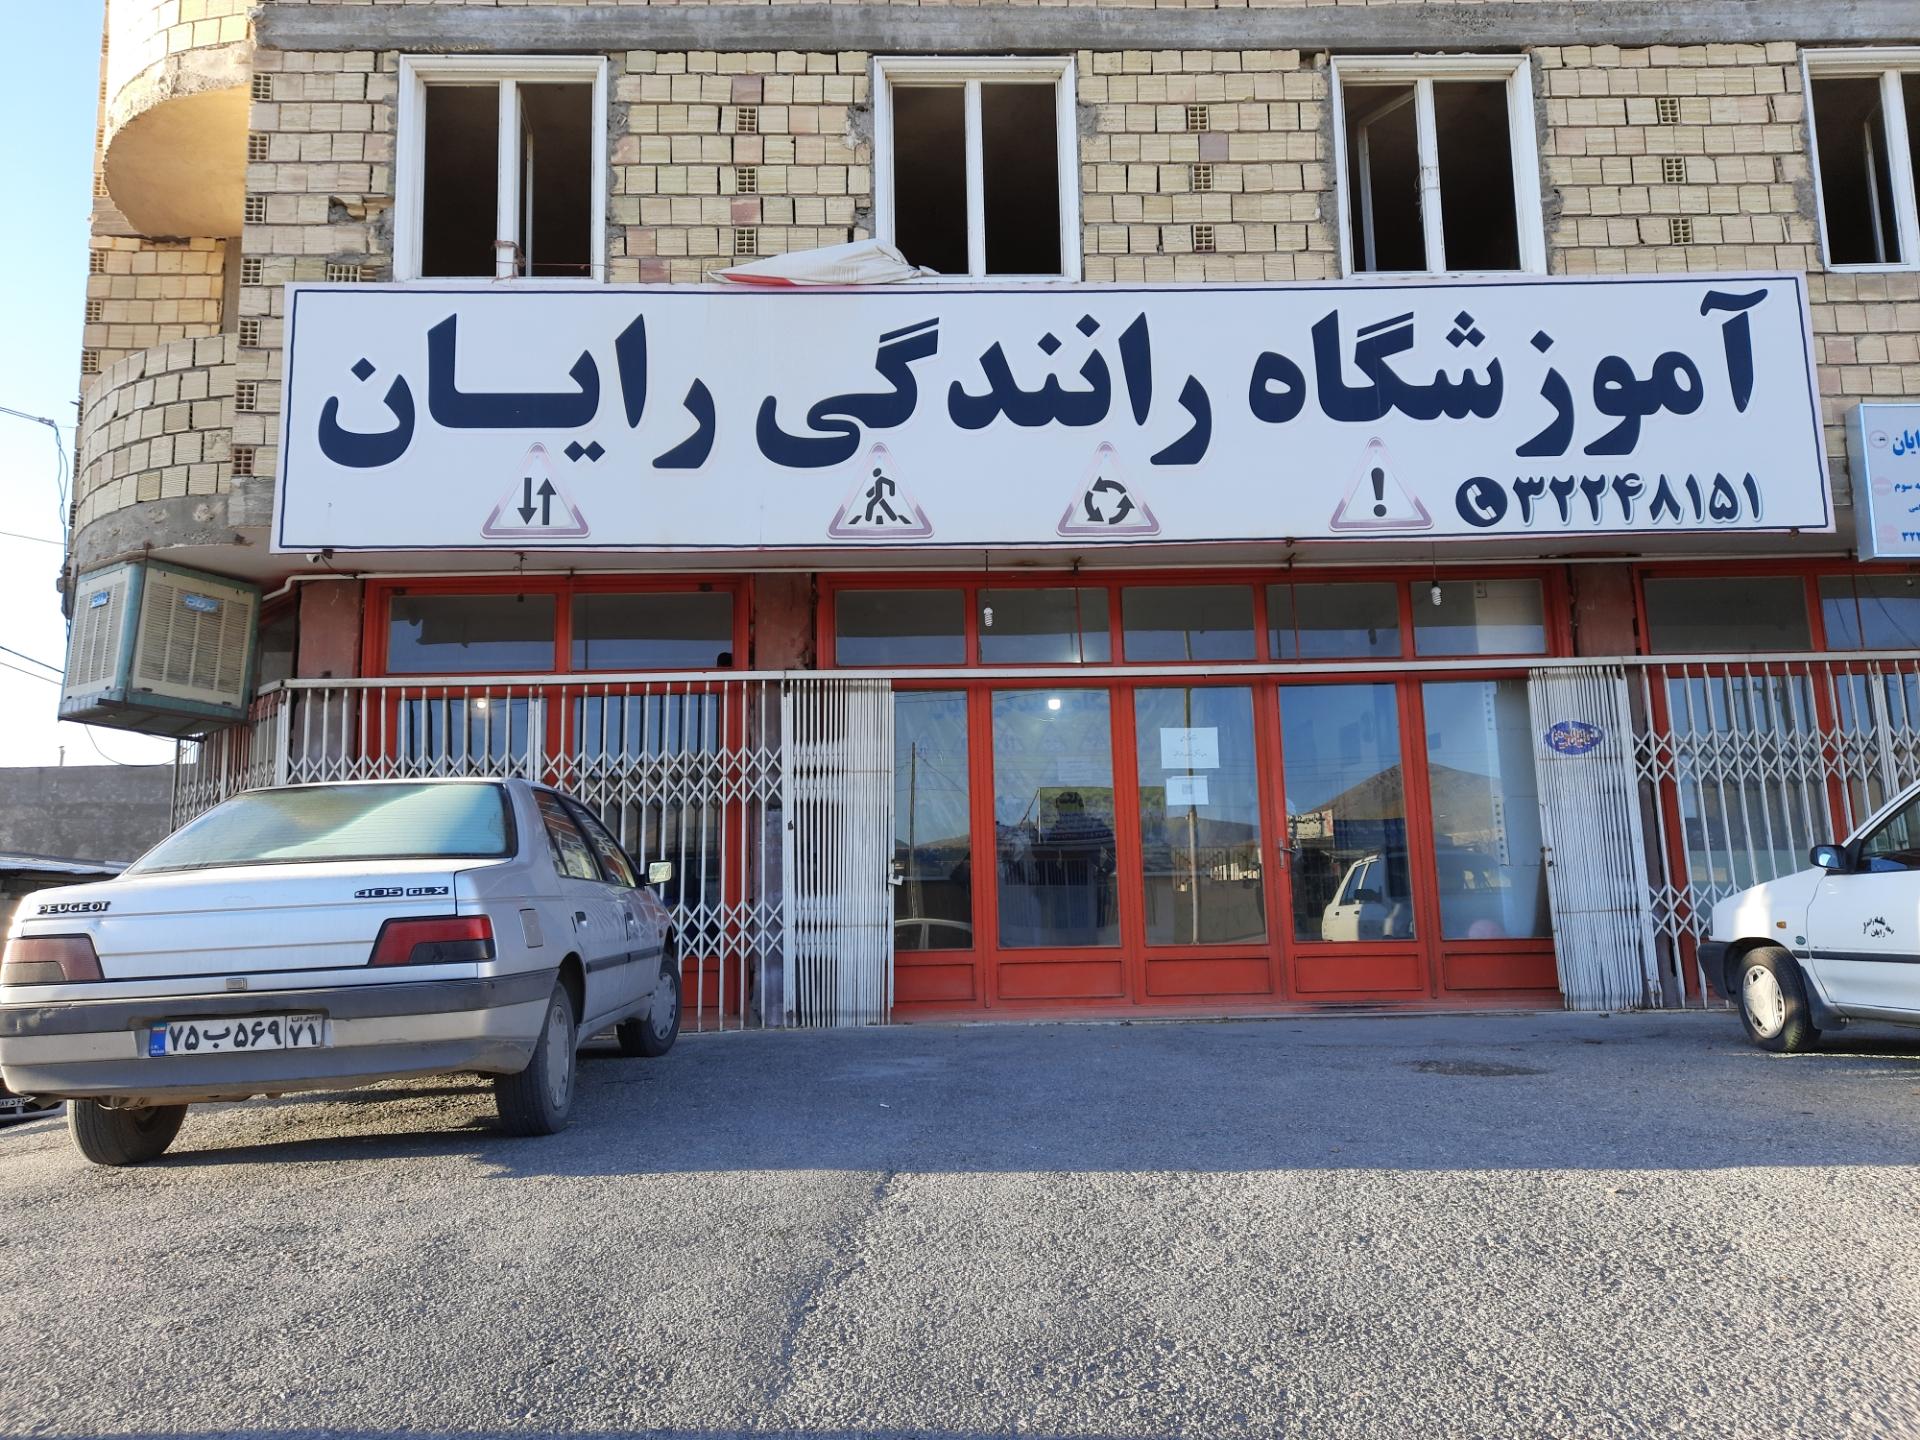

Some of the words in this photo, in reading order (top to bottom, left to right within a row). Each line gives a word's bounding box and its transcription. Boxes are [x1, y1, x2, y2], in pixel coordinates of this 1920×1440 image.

[317, 312, 716, 468] رایان
[755, 311, 1212, 468] رانندگی
[1248, 288, 1768, 458] آموزشگاه
[1892, 429, 1920, 456] ایان
[1512, 472, 1762, 524] ۳۲۲۴۸۱۵۱
[38, 901, 111, 915] PEUGEOT
[354, 887, 403, 898] 405
[407, 886, 448, 896] GLX
